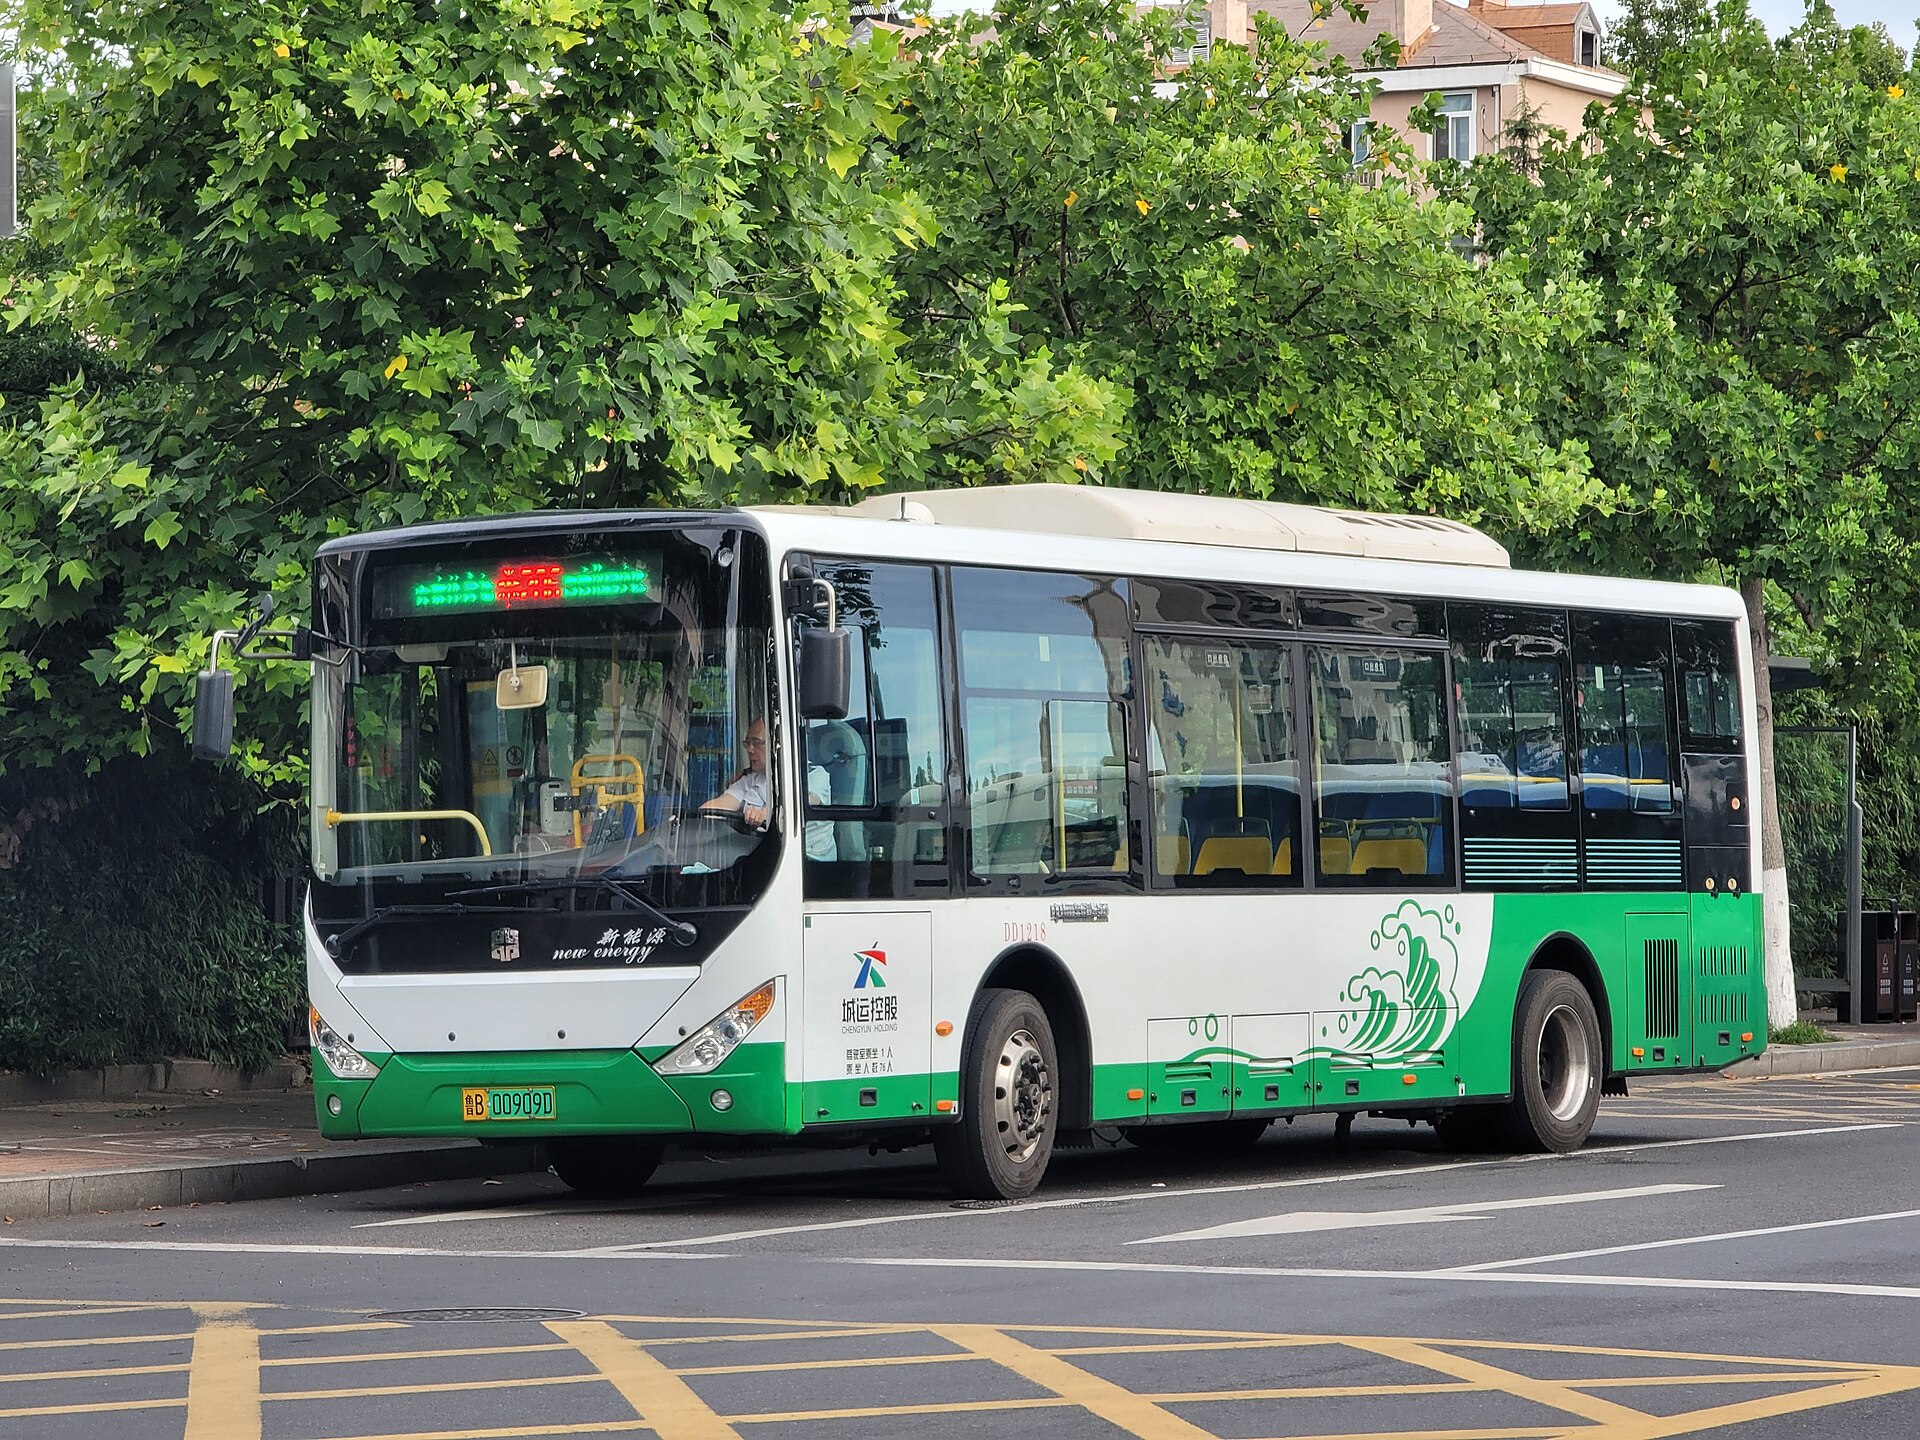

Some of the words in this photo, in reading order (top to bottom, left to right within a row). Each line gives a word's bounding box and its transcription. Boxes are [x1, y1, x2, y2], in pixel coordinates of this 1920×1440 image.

[597, 928, 667, 946] 新能源
[1004, 922, 1047, 941] DD1218
[553, 946, 590, 960] new
[594, 944, 656, 964] energy
[842, 995, 898, 1023] 城运控股
[842, 1025, 872, 1034] CHENGYUN
[874, 1023, 898, 1033] HOLDING
